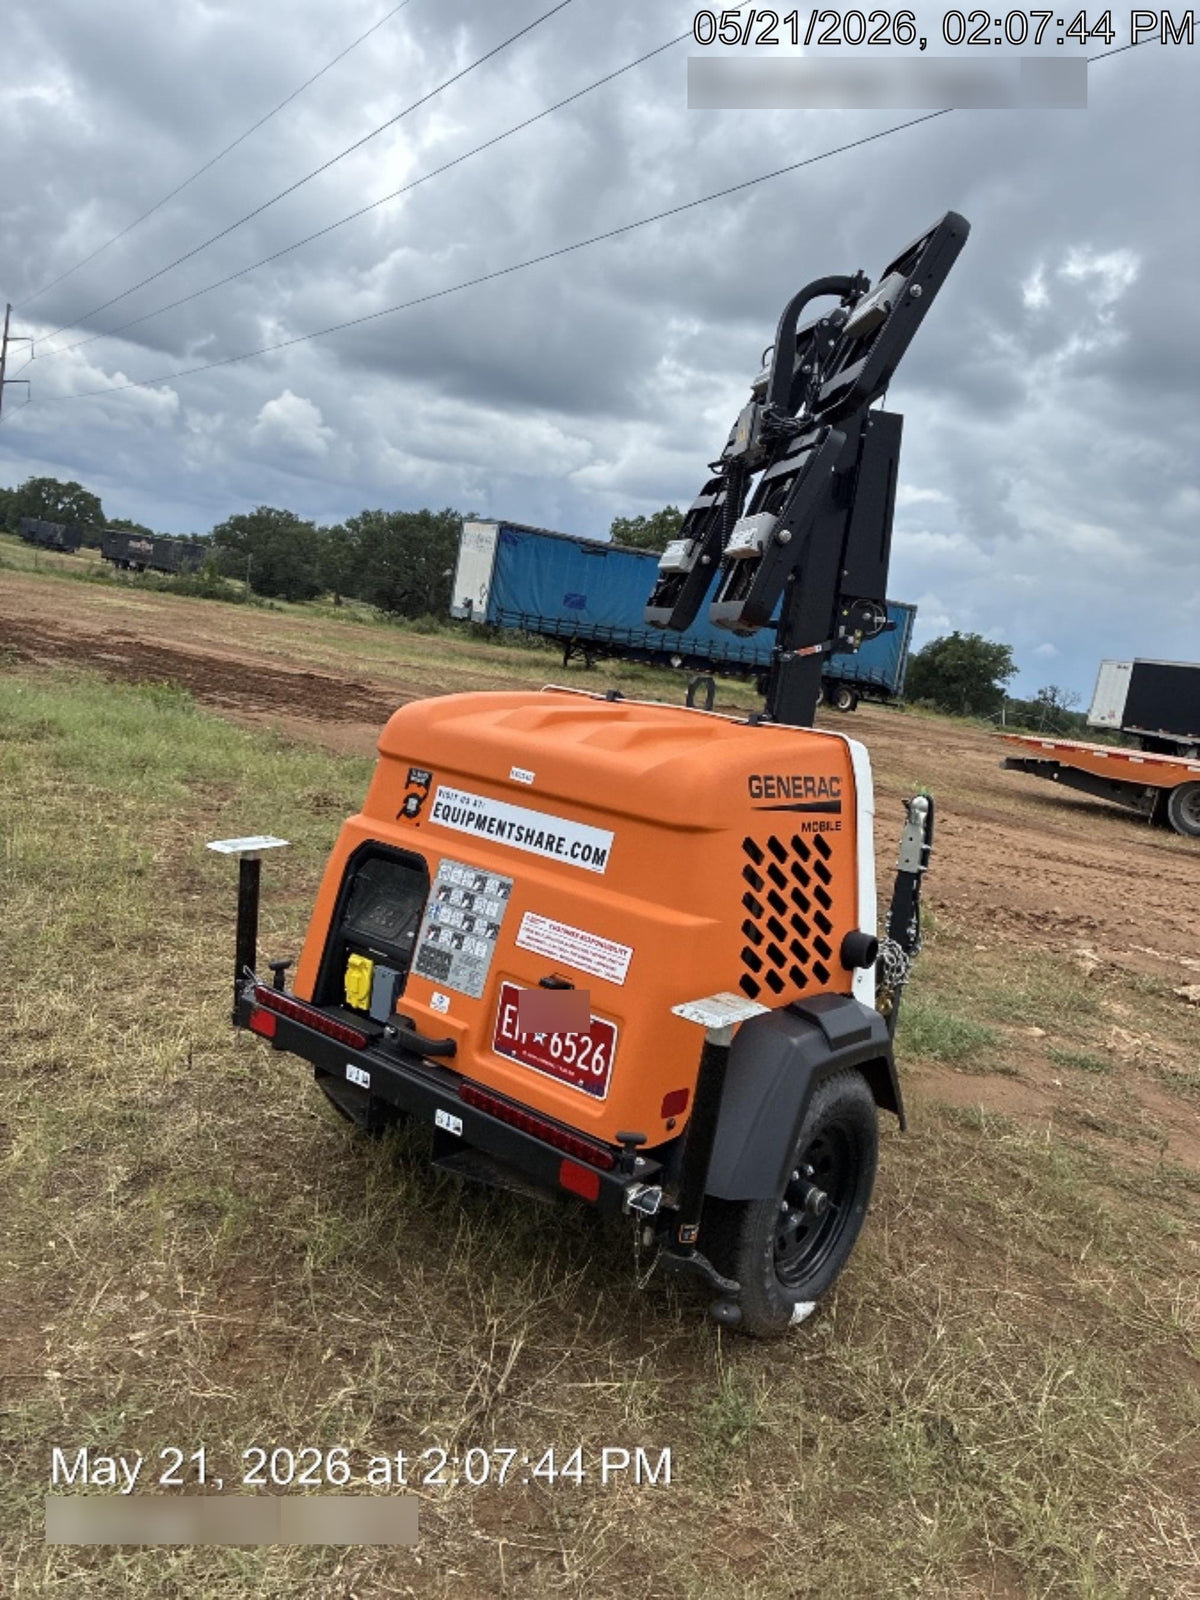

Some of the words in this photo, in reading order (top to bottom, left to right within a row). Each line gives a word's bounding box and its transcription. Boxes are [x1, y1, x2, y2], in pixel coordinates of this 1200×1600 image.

[748, 774, 842, 799] GENERAC
[432, 801, 608, 868] EQUIPMENTSHARE.COM
[801, 820, 842, 833] MOBILE
[549, 1031, 606, 1077] 6526
